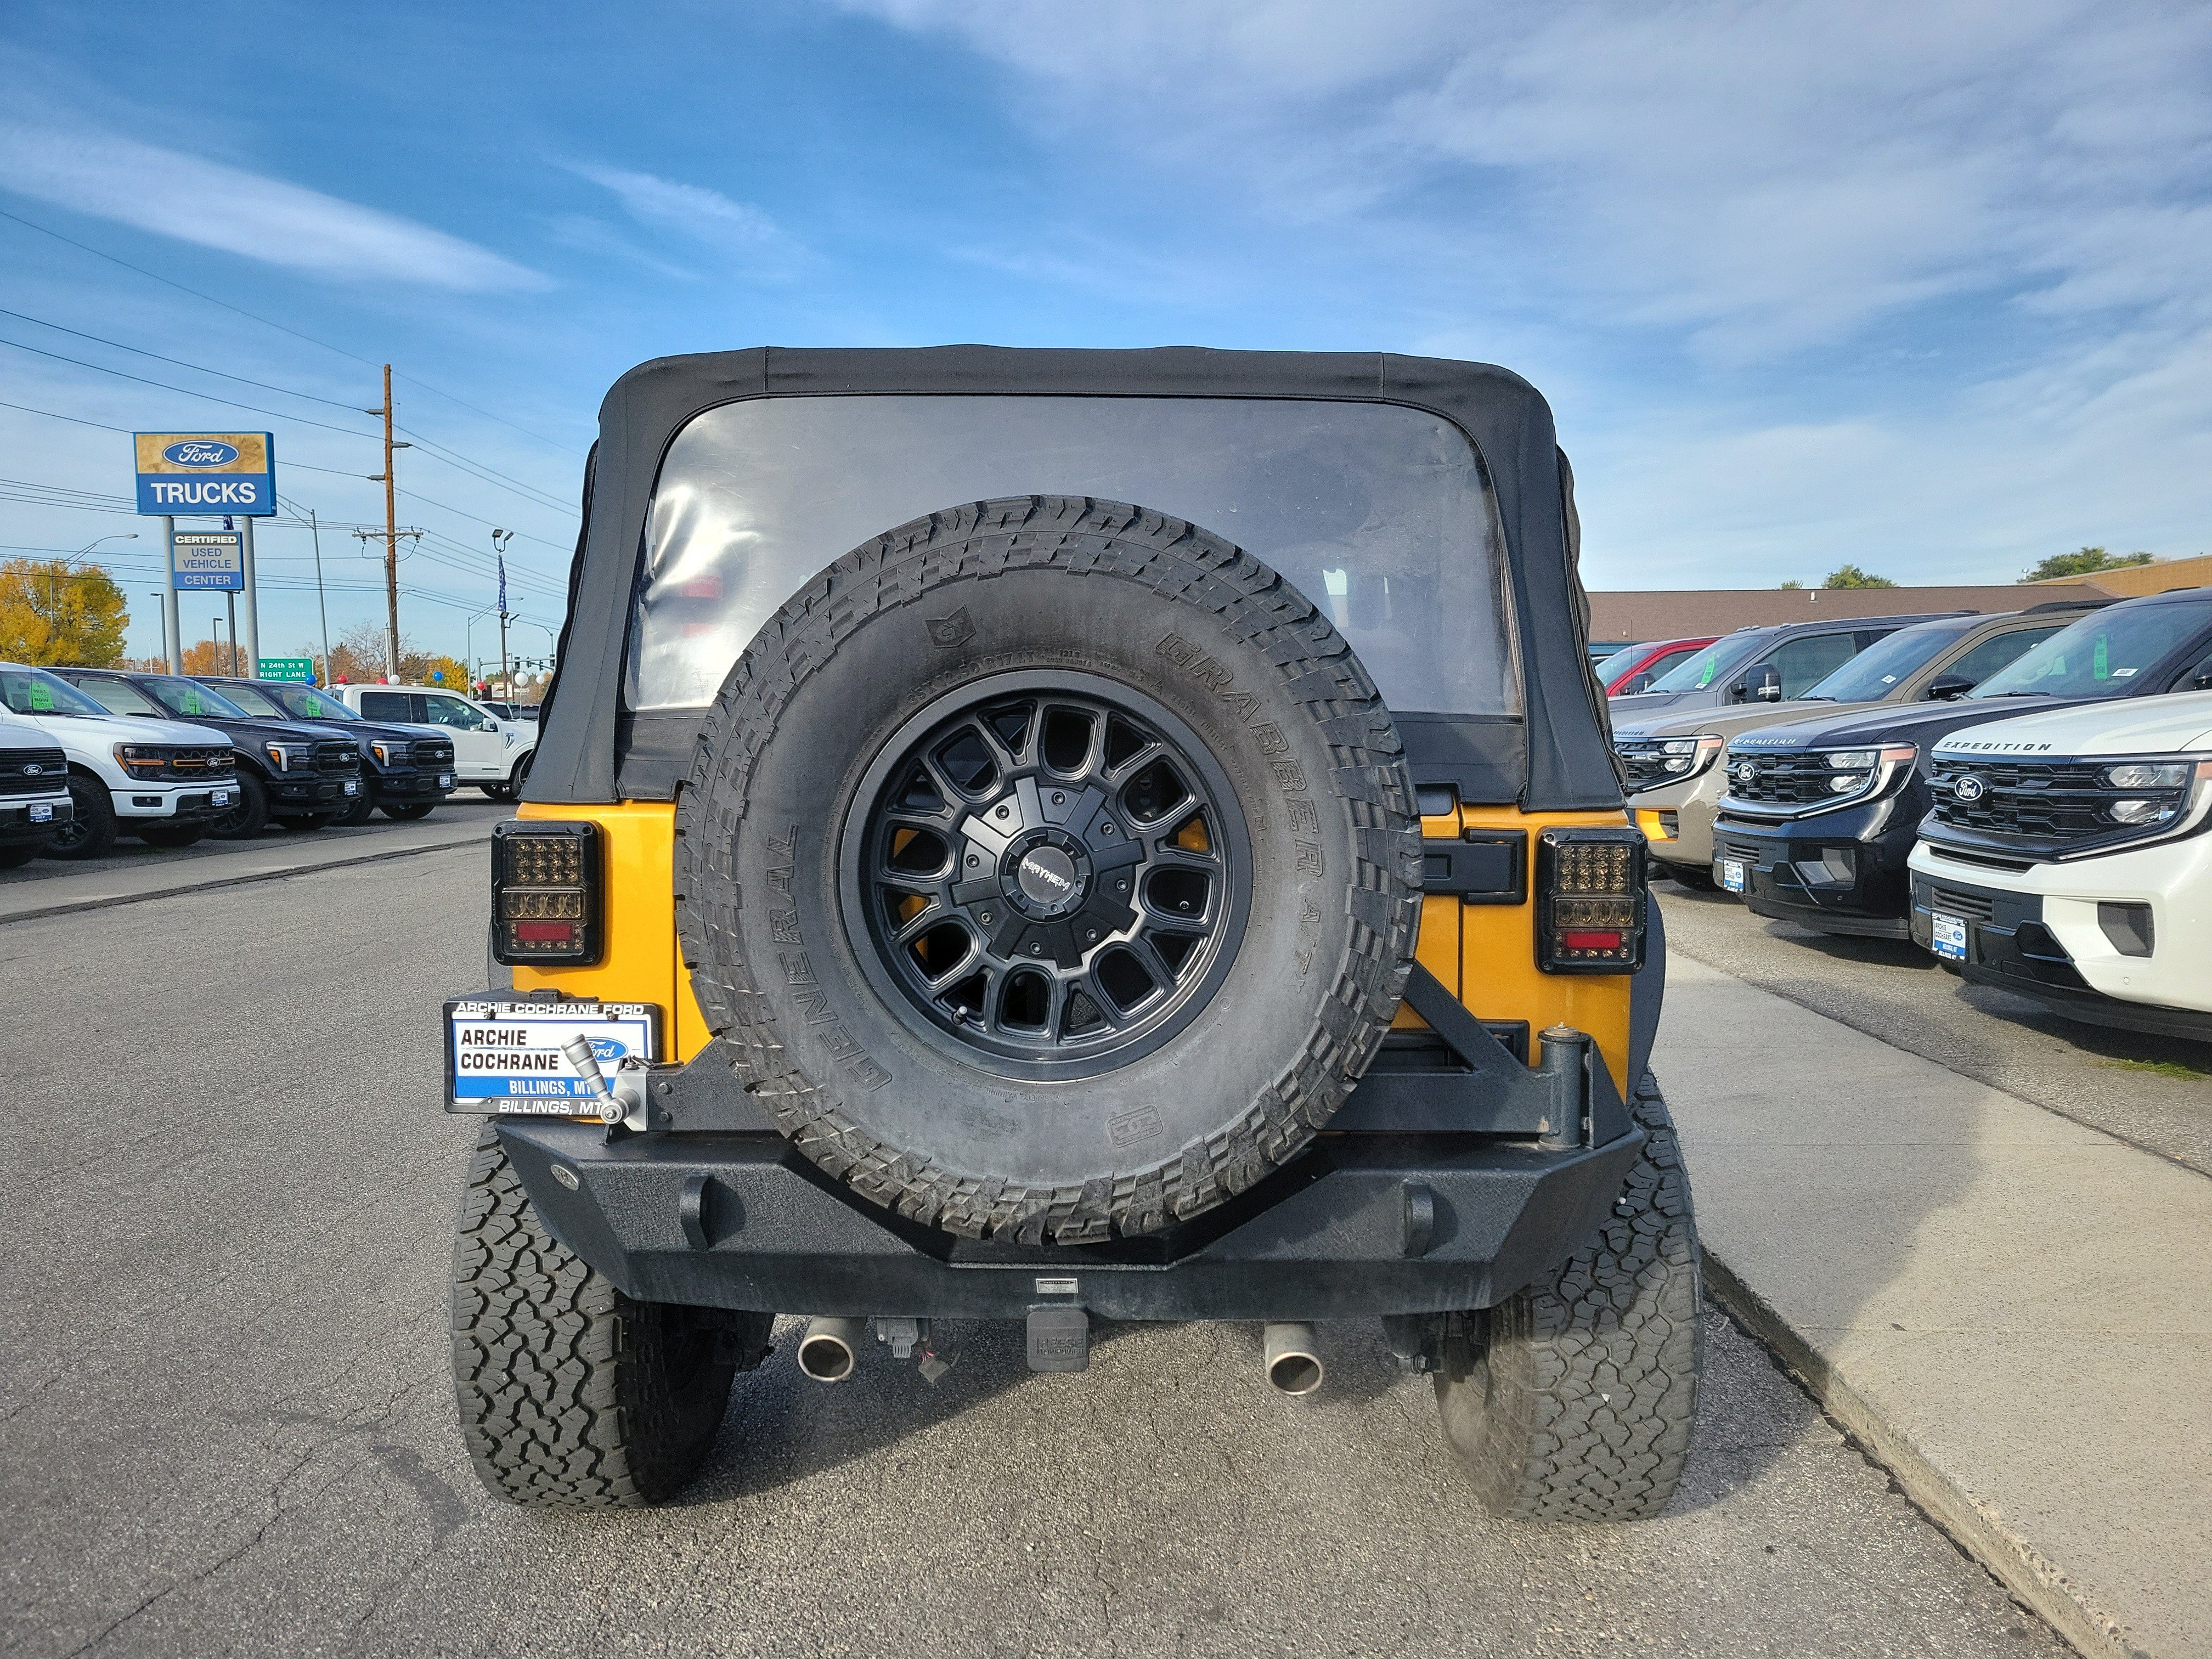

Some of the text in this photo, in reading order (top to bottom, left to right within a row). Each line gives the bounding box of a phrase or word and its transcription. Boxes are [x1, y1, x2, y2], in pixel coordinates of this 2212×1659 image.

[178, 444, 224, 462] Ford
[151, 482, 256, 504] TRUCKS
[175, 535, 237, 544] CERTIFIED
[191, 548, 222, 557] USED
[183, 560, 232, 568] VEHICLE
[184, 575, 231, 585] CENTER
[1156, 631, 1324, 877] GRABBER
[1943, 741, 2052, 751] EXPEDITION
[1959, 780, 1978, 797] Ford
[1022, 858, 1070, 891] MAYHEM
[766, 823, 893, 1092] GENERAL
[456, 1002, 645, 1015] ARCHIE COCHRANE FORD
[461, 1029, 527, 1046] ARCHIE
[461, 1053, 558, 1070] COCHRANE
[510, 1080, 570, 1096] BILLINGS,
[499, 1100, 602, 1115] BILLINGS, MT
